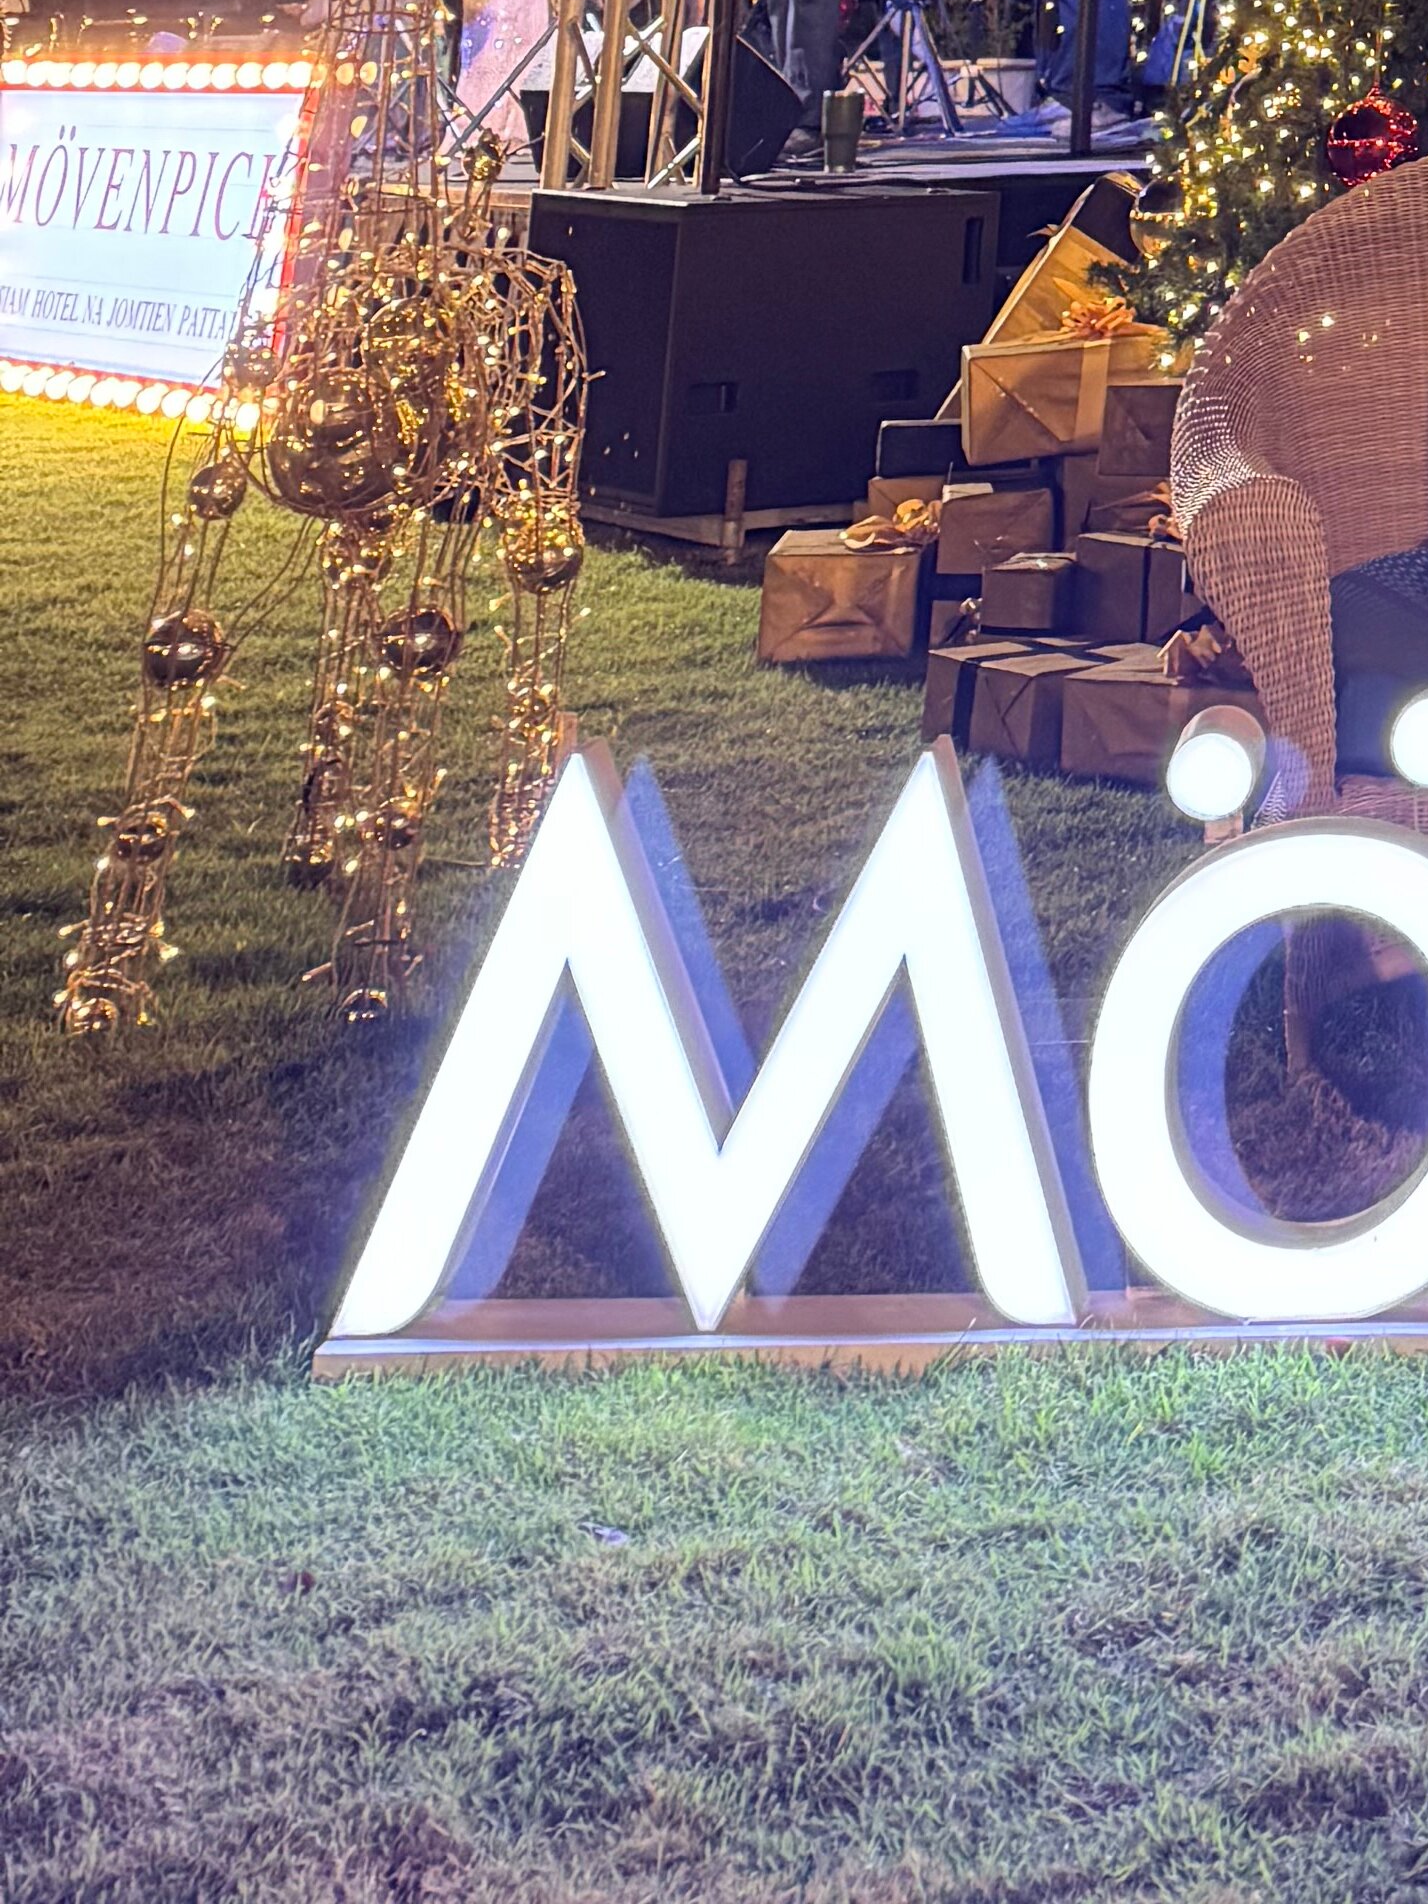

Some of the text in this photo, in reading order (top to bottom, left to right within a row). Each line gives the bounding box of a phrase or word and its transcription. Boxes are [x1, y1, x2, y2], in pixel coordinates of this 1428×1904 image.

[0, 285, 31, 316] IAM
[31, 289, 79, 322] HOTEL
[82, 294, 104, 326] NA
[106, 297, 177, 333] JOMTIEN
